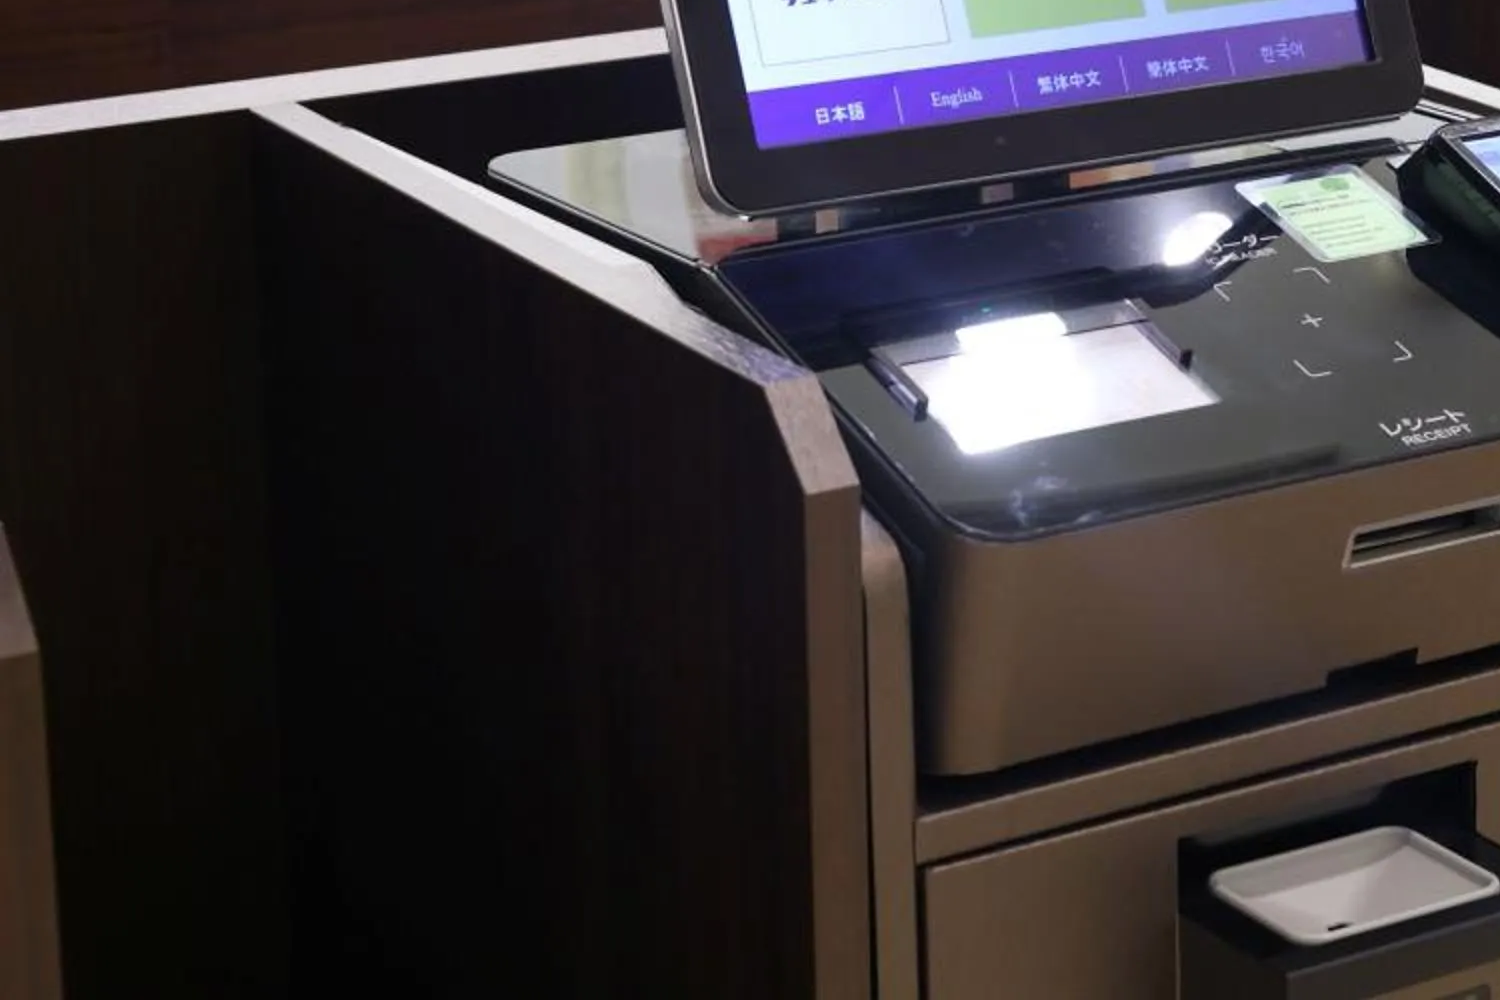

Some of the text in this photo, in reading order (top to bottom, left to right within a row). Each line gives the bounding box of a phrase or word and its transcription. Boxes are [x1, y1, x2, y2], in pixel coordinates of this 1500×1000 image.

[1260, 36, 1306, 64] 한국어
[930, 87, 983, 109] English
[815, 101, 865, 125] 日本語
[1379, 408, 1466, 437] レシート
[1401, 423, 1472, 447] RECEIPT
